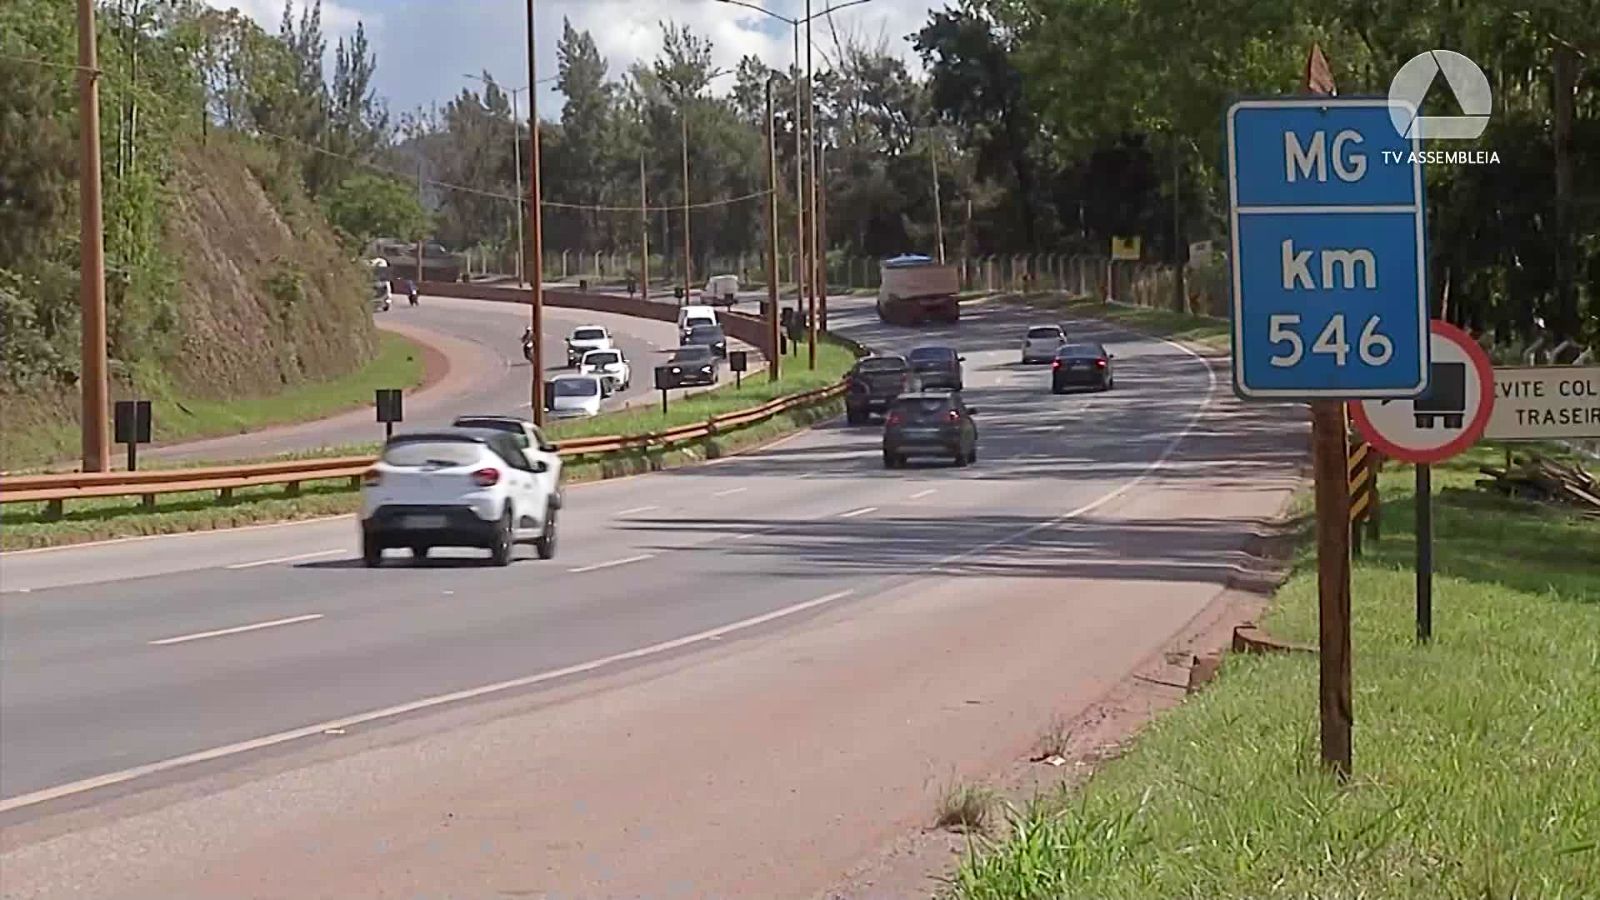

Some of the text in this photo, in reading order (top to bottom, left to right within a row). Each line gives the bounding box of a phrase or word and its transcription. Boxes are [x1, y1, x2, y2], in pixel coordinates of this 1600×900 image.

[1284, 129, 1368, 182] MG
[1281, 239, 1377, 289] km
[1268, 313, 1394, 367] 546
[1559, 380, 1598, 397] COL
[1515, 407, 1600, 425] TRASEIR
